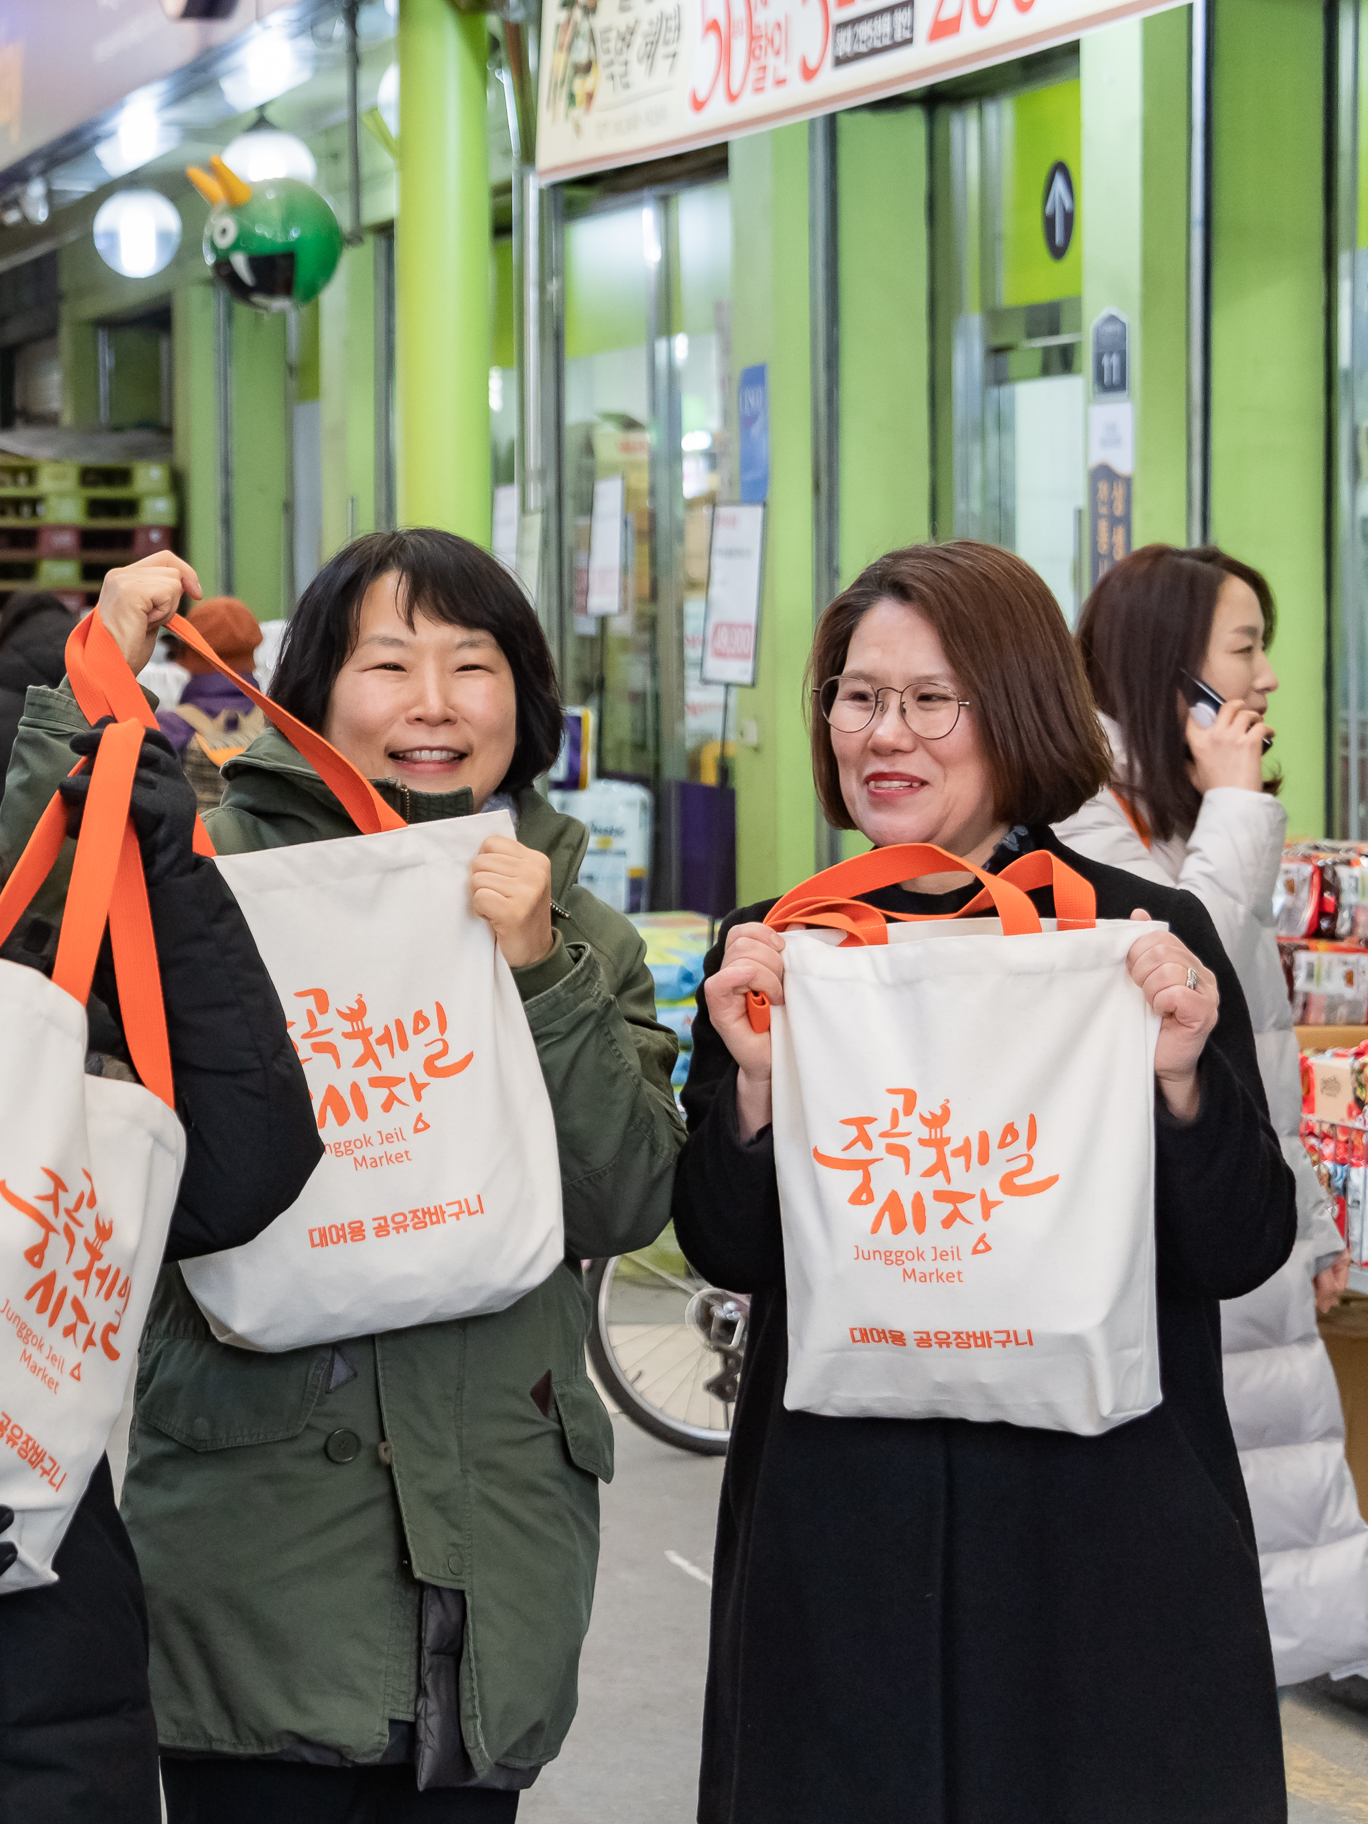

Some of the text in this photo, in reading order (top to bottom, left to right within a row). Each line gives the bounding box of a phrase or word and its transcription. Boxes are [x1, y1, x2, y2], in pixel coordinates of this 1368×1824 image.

[751, 13, 788, 94] 할인
[1102, 352, 1121, 387] 11
[286, 988, 474, 1102] 곡제일
[317, 1072, 431, 1134] 시장
[324, 1127, 407, 1159] nggok Jeil
[353, 1149, 412, 1171] Market
[813, 1088, 1060, 1207] 중곡제일
[308, 1193, 485, 1249] 대여용 공유장바구니
[870, 1187, 1005, 1256] 시장
[853, 1244, 963, 1267] Junggok Jeil
[902, 1267, 964, 1284] Market
[0, 1298, 65, 1375] Junggok Jeil
[24, 1269, 98, 1383] 시장
[848, 1326, 1034, 1350] 대여용 공유장바구니
[19, 1347, 61, 1395] Market
